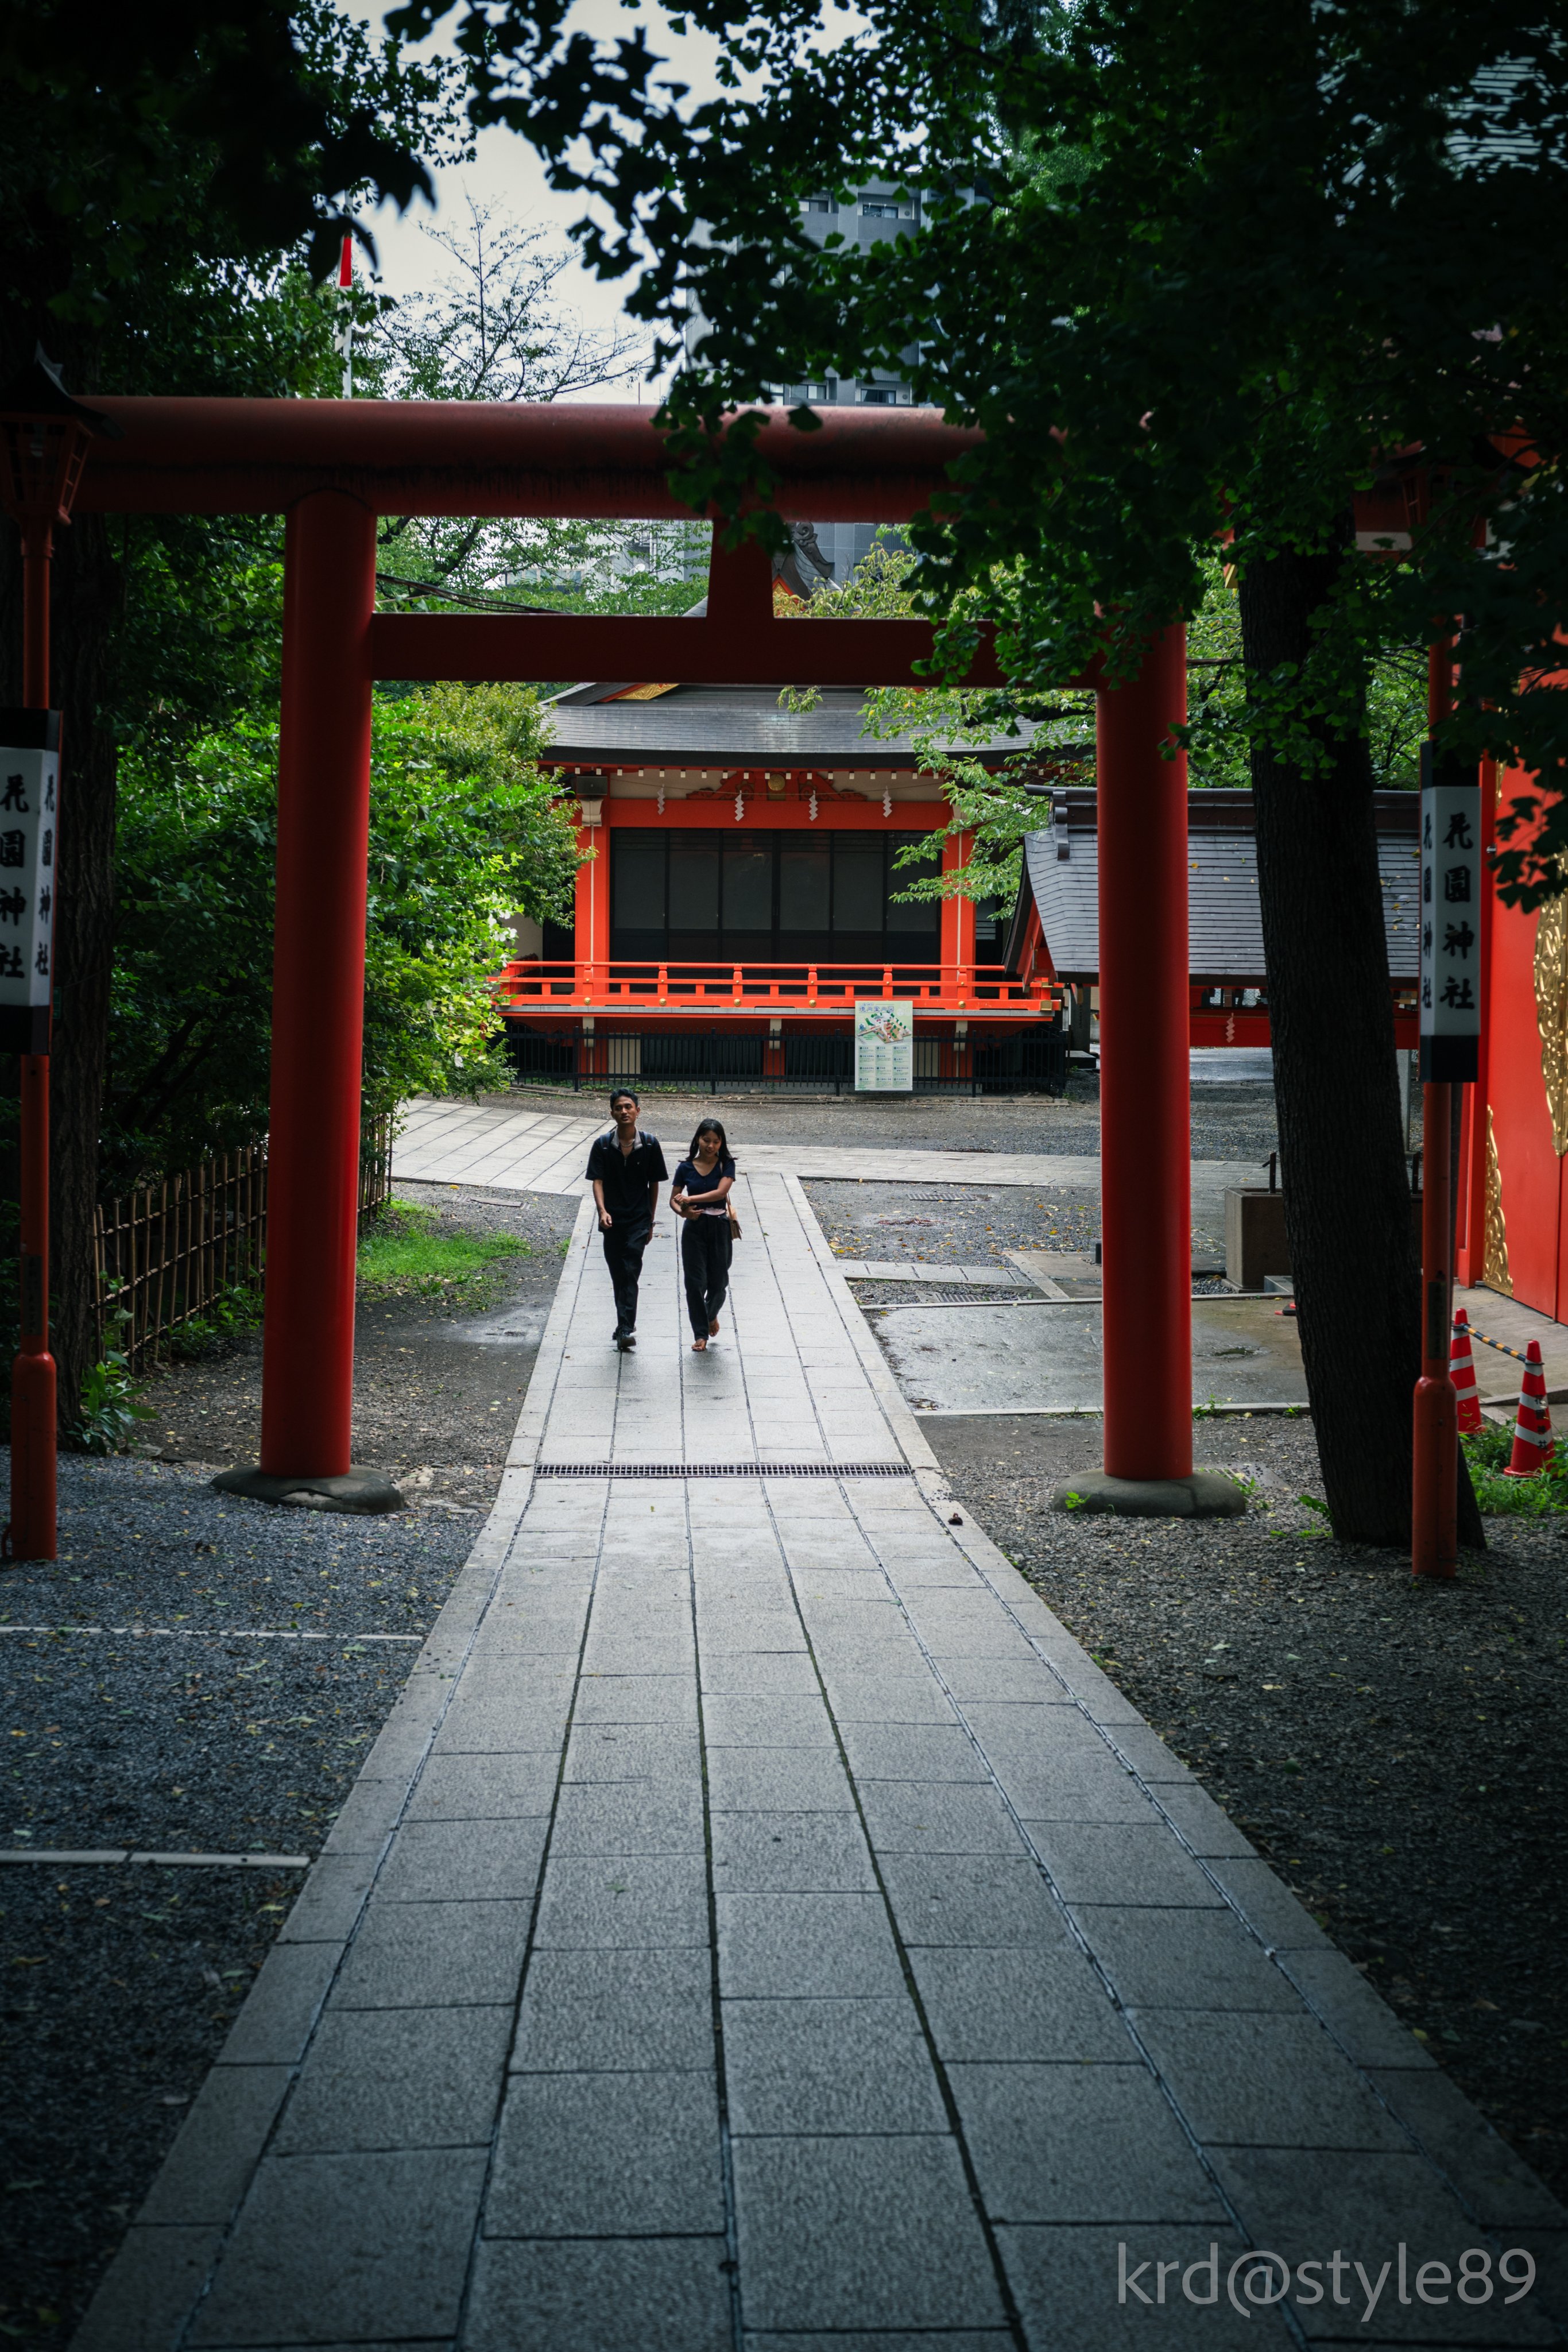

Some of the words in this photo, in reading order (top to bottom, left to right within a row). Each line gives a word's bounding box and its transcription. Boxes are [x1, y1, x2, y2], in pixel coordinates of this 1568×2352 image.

[0, 773, 29, 978] 花園神社
[35, 773, 55, 975] 花園神社
[1422, 812, 1433, 1008] 花園神社
[1440, 812, 1475, 1009] 花園神社
